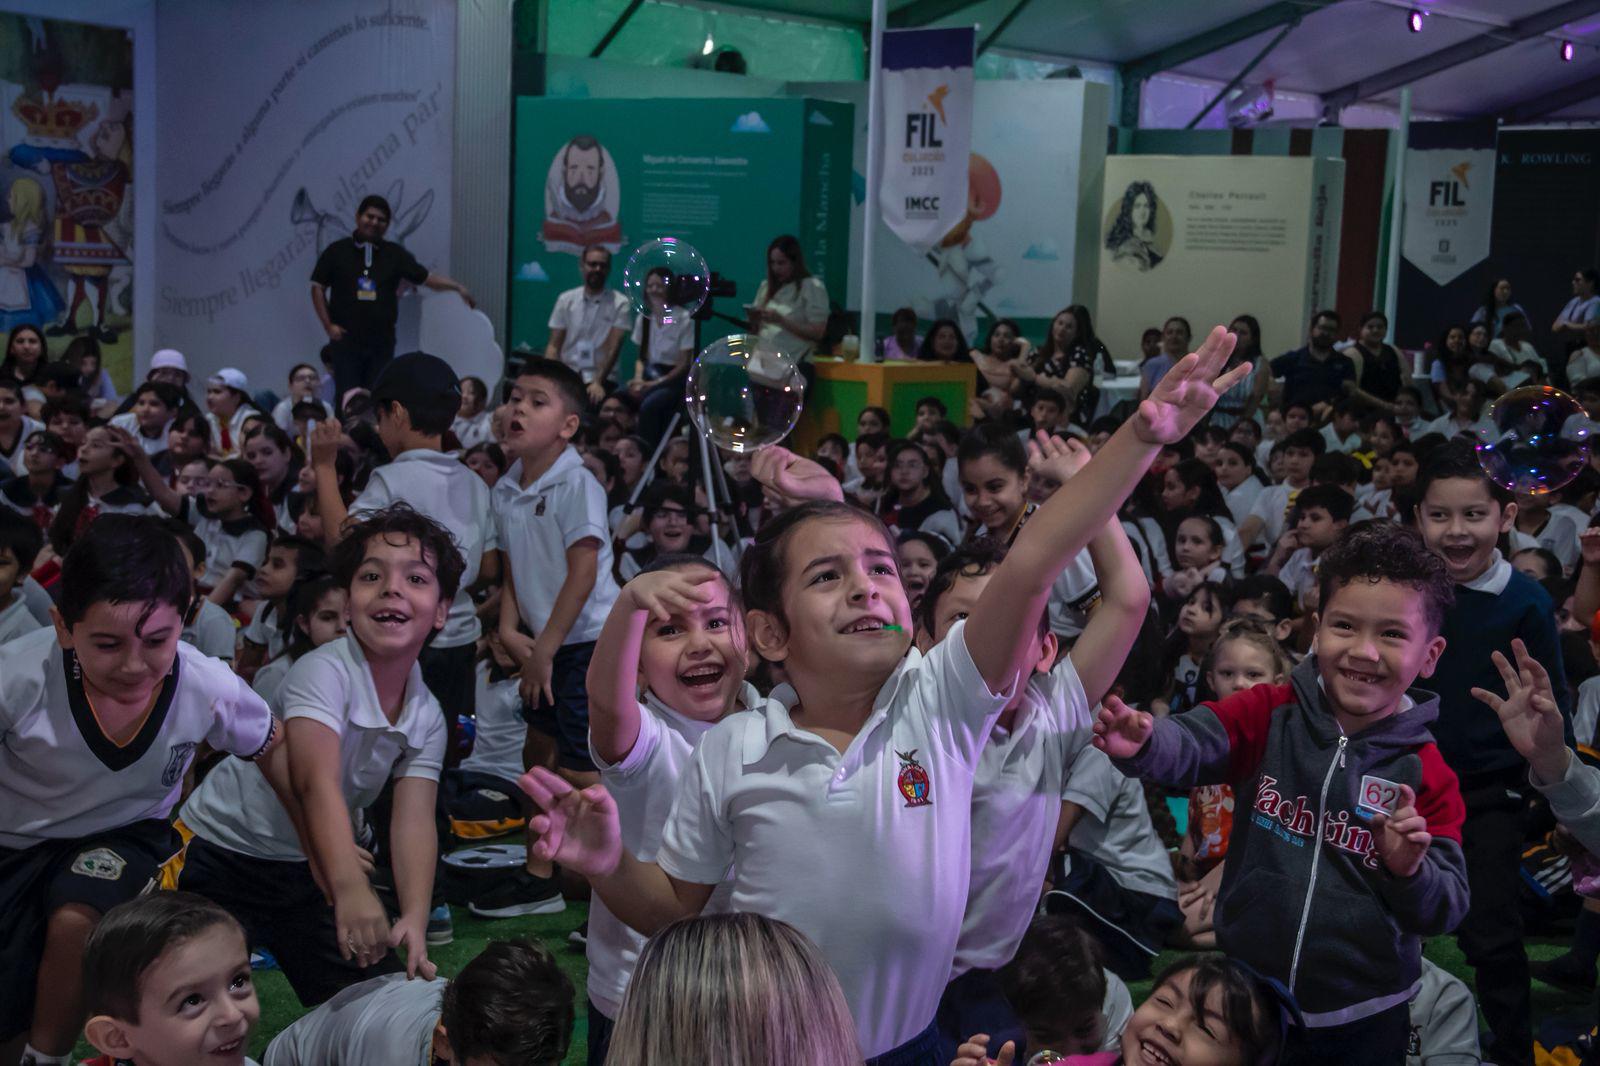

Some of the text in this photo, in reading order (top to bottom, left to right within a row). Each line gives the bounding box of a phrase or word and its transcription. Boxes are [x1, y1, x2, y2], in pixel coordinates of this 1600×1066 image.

[905, 113, 943, 149] FIL
[1520, 152, 1592, 166] ROWLING
[159, 284, 239, 324] Siempre
[403, 82, 442, 146] par
[815, 153, 831, 232] Mancha
[905, 196, 940, 211] IMCC
[1429, 180, 1466, 207] FIL
[1366, 783, 1397, 809] 62
